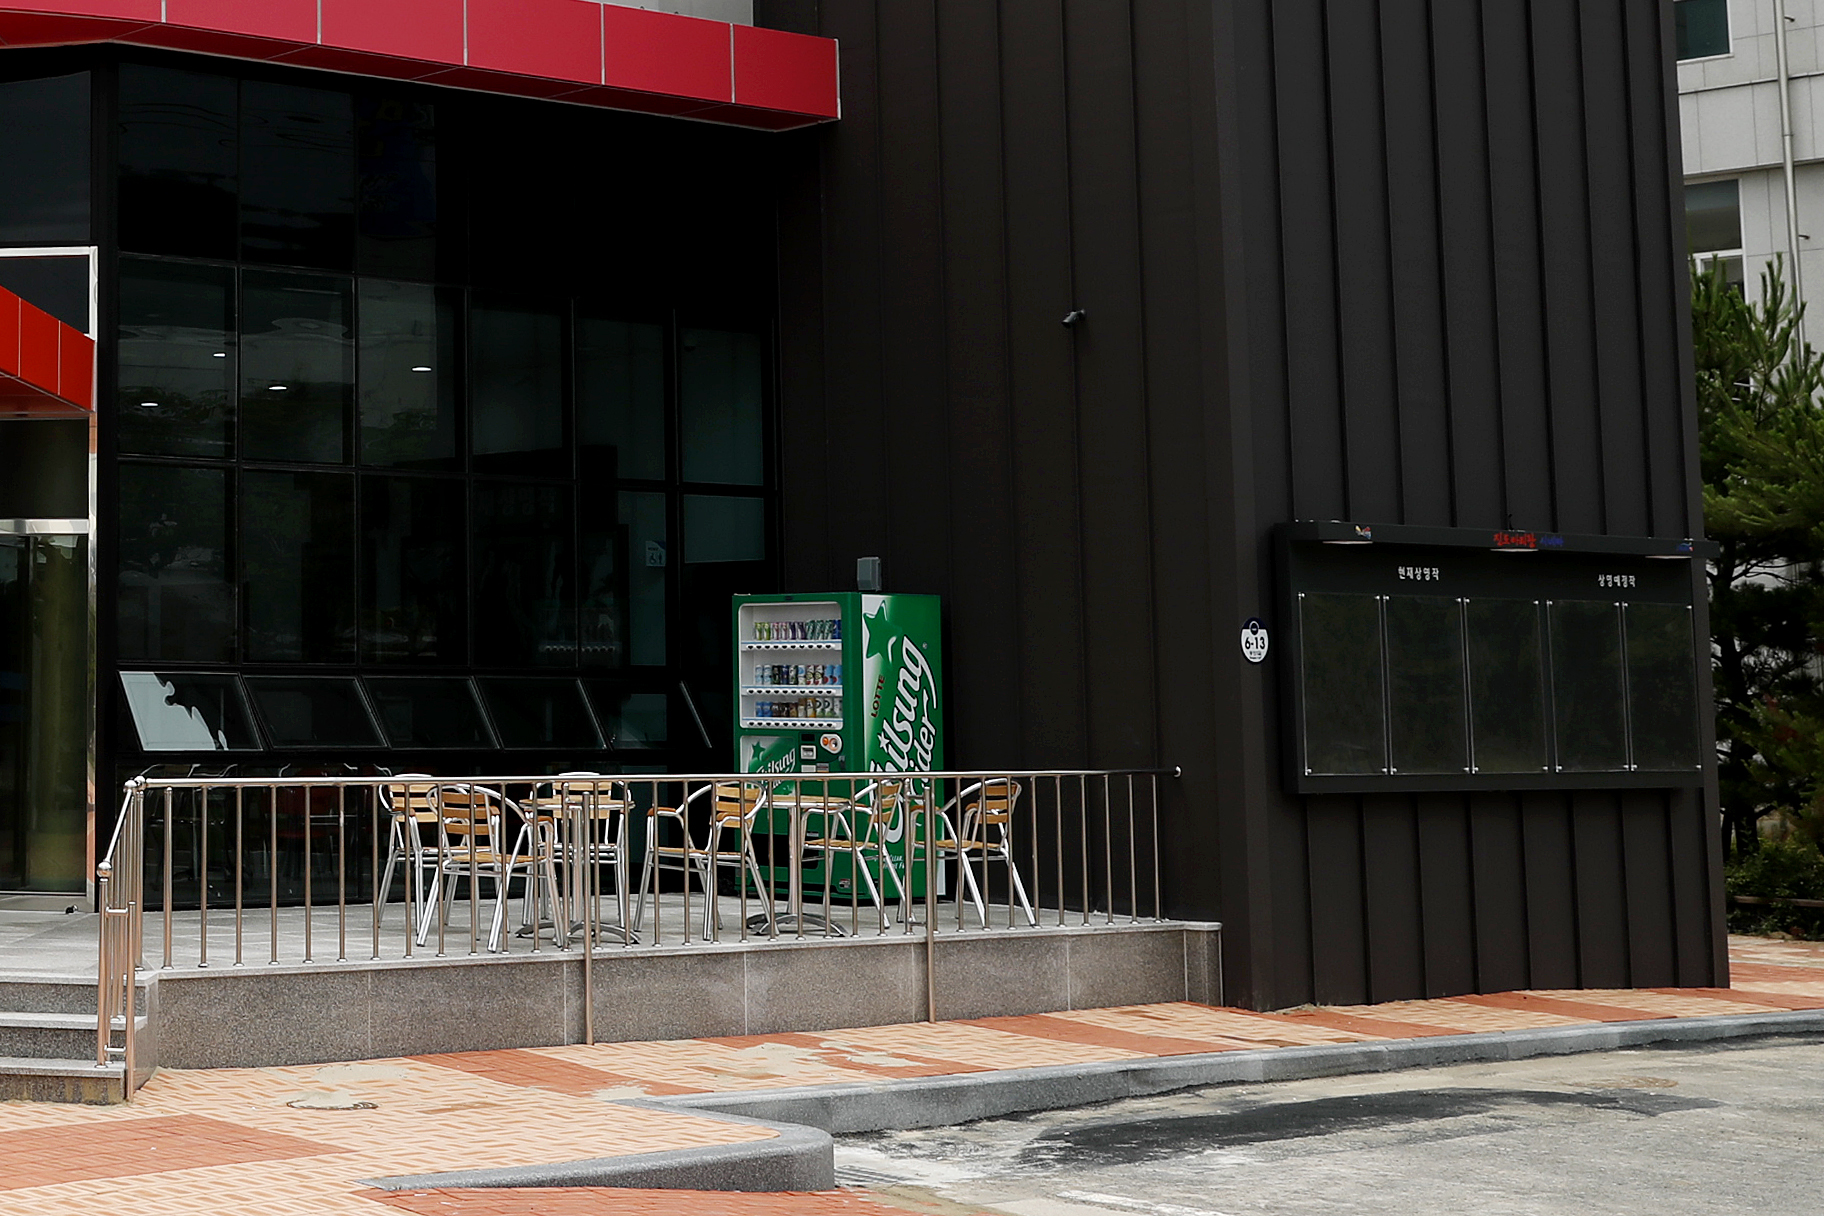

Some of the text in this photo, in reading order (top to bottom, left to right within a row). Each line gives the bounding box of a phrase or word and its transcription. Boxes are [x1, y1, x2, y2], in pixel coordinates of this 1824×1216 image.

[1397, 565, 1440, 581] 현재상영작
[1244, 636, 1266, 650] 6-13
[870, 674, 886, 719] LOTTE
